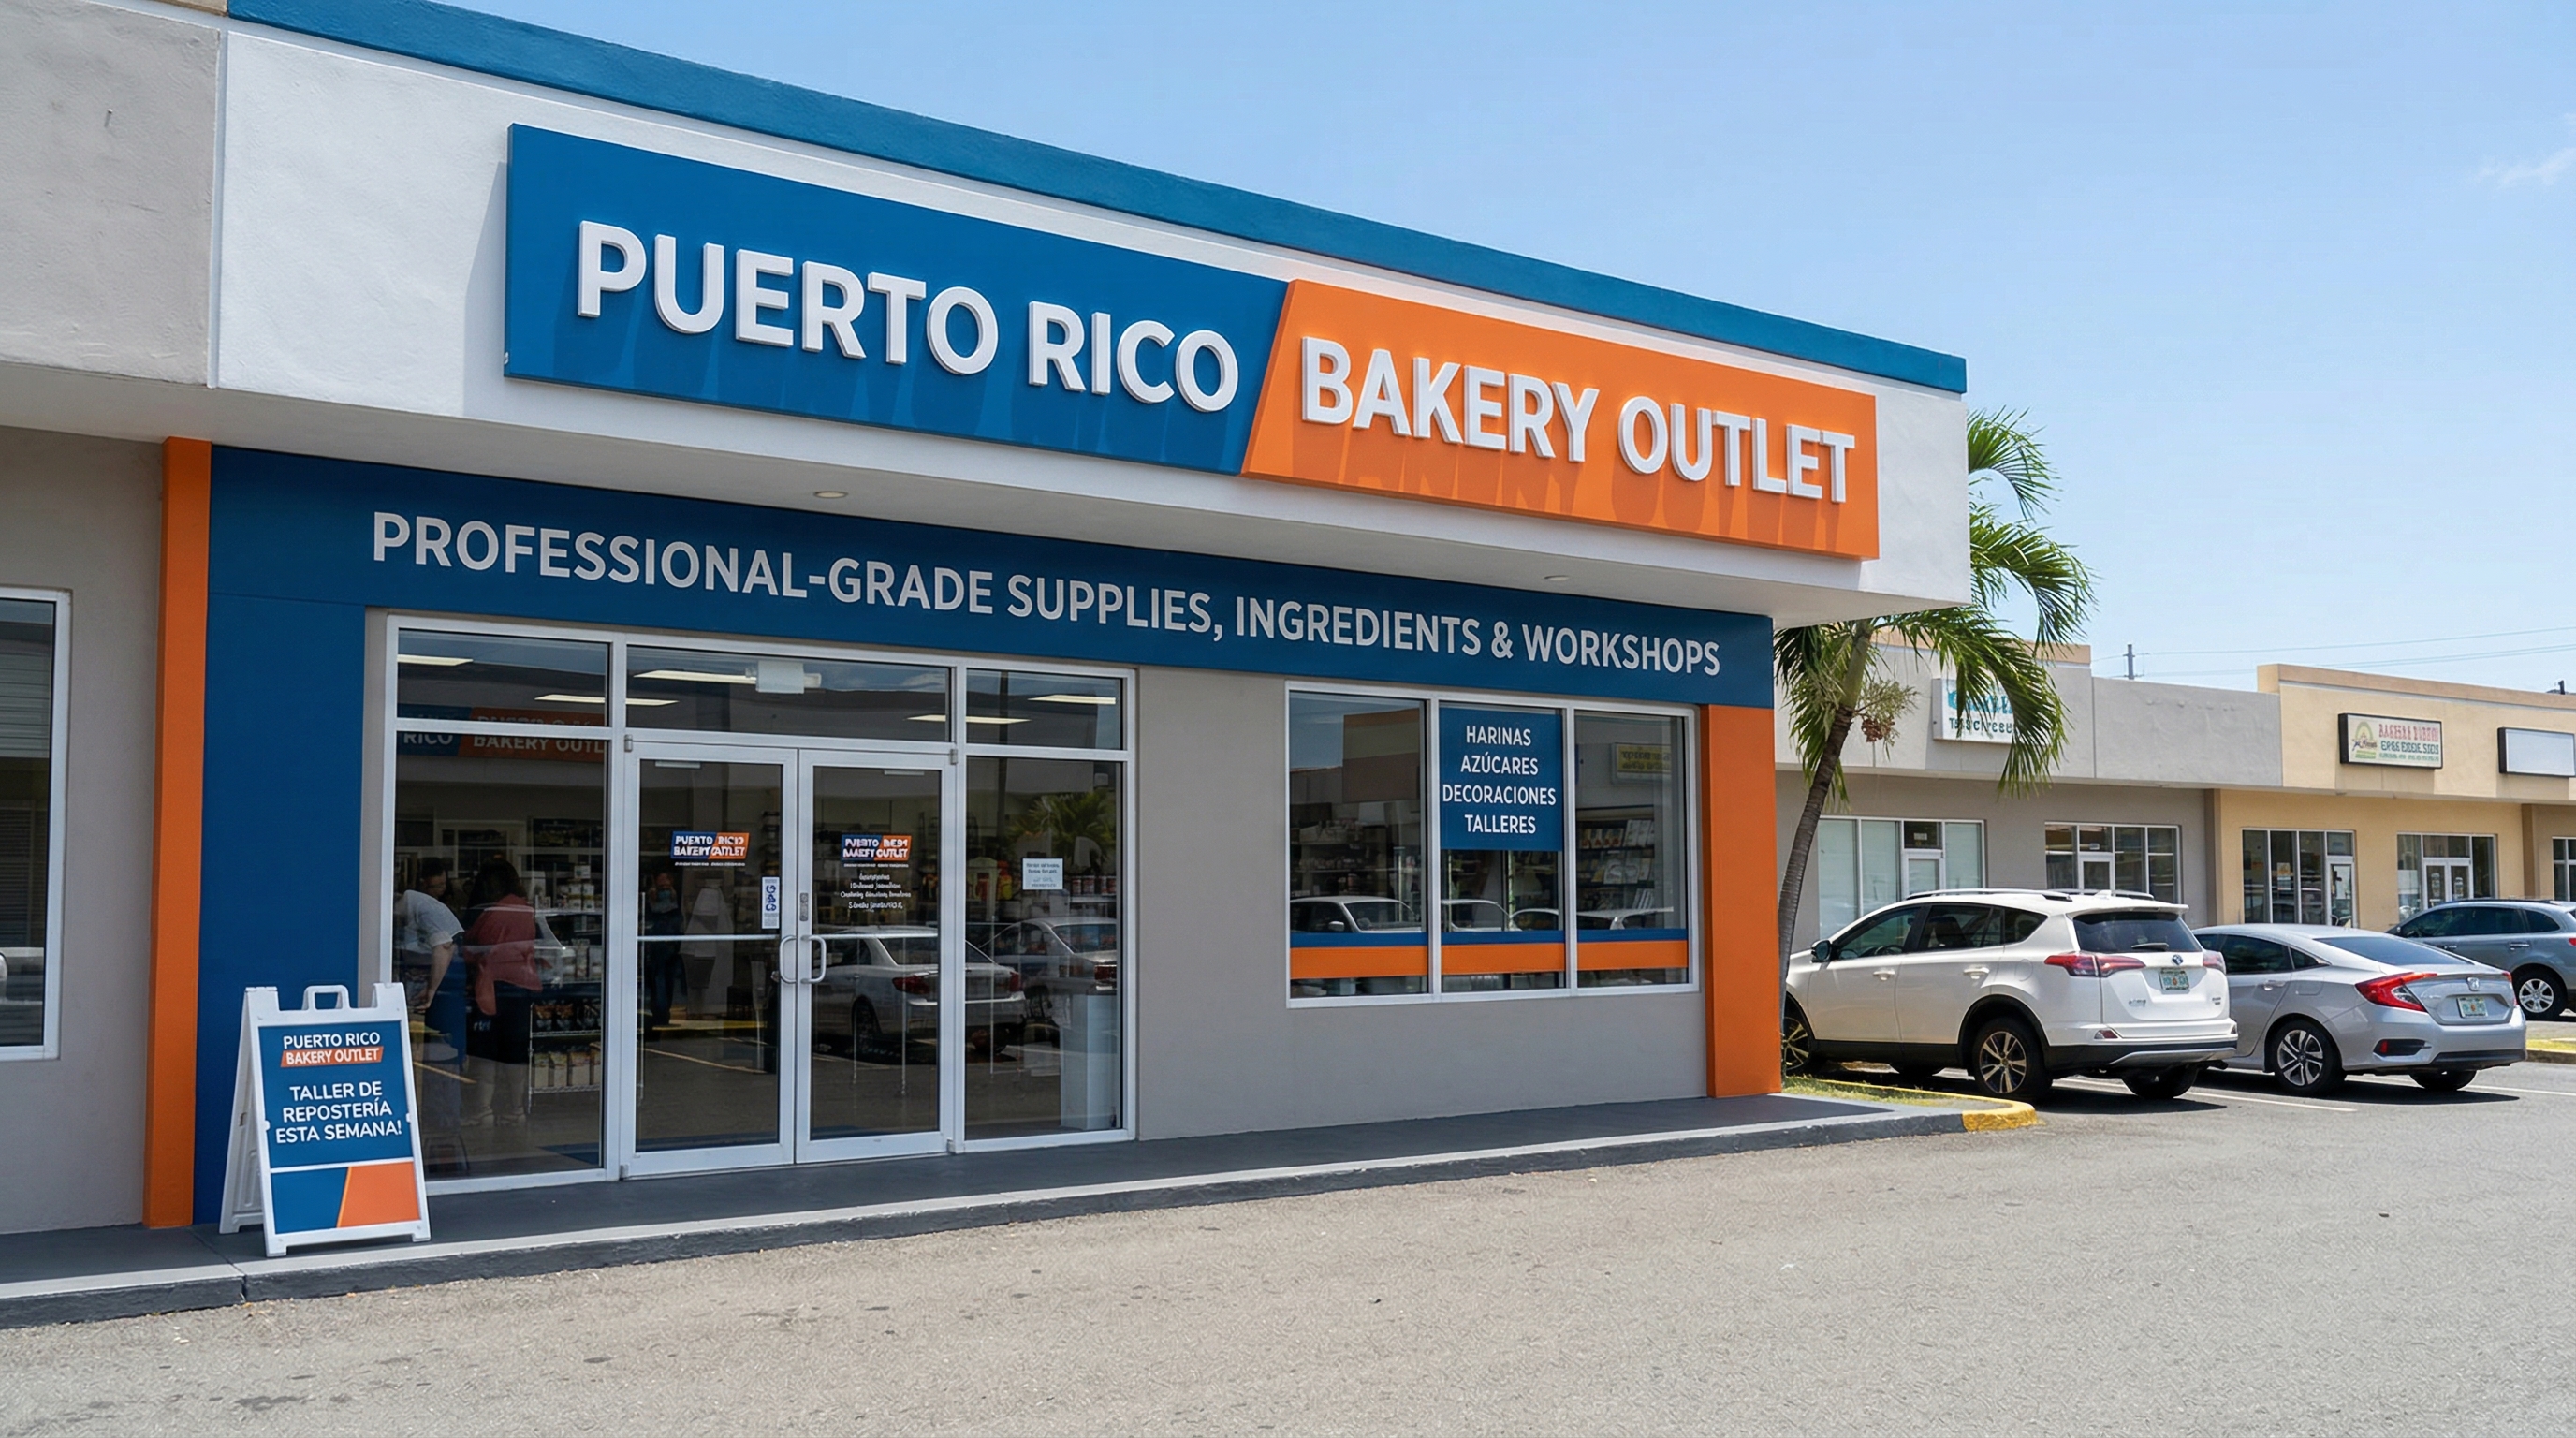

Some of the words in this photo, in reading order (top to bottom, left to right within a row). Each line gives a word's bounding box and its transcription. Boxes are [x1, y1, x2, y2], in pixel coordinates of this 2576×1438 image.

[578, 220, 998, 375] PUERTO
[1028, 301, 1239, 413] RICO
[1301, 336, 1600, 462] BAKERY
[1618, 396, 1855, 503] OUTLET
[373, 511, 994, 614] PROFESSIONAL-GRADE
[1007, 574, 1223, 642] SUPPLIES,
[1237, 596, 1481, 656] INGREDIENTS
[1490, 621, 1514, 659] &
[1522, 624, 1720, 676] WORKSHOPS
[474, 735, 549, 751] BAKERY
[1466, 725, 1531, 747] HARINAS
[1460, 752, 1539, 776] AZÚCARES
[1442, 784, 1557, 806] DECORACIONES
[1464, 814, 1537, 834] TALLERES
[283, 1033, 343, 1049] PUERTO
[345, 1031, 381, 1046] RICO
[285, 1049, 332, 1065] BAKERY
[334, 1047, 380, 1063] OUTLET
[289, 1082, 355, 1101] TALLER
[359, 1080, 383, 1097] DE
[283, 1097, 393, 1123] REPOSTERÍA
[275, 1125, 321, 1144] ESTA
[324, 1120, 402, 1140] SEMANA!
